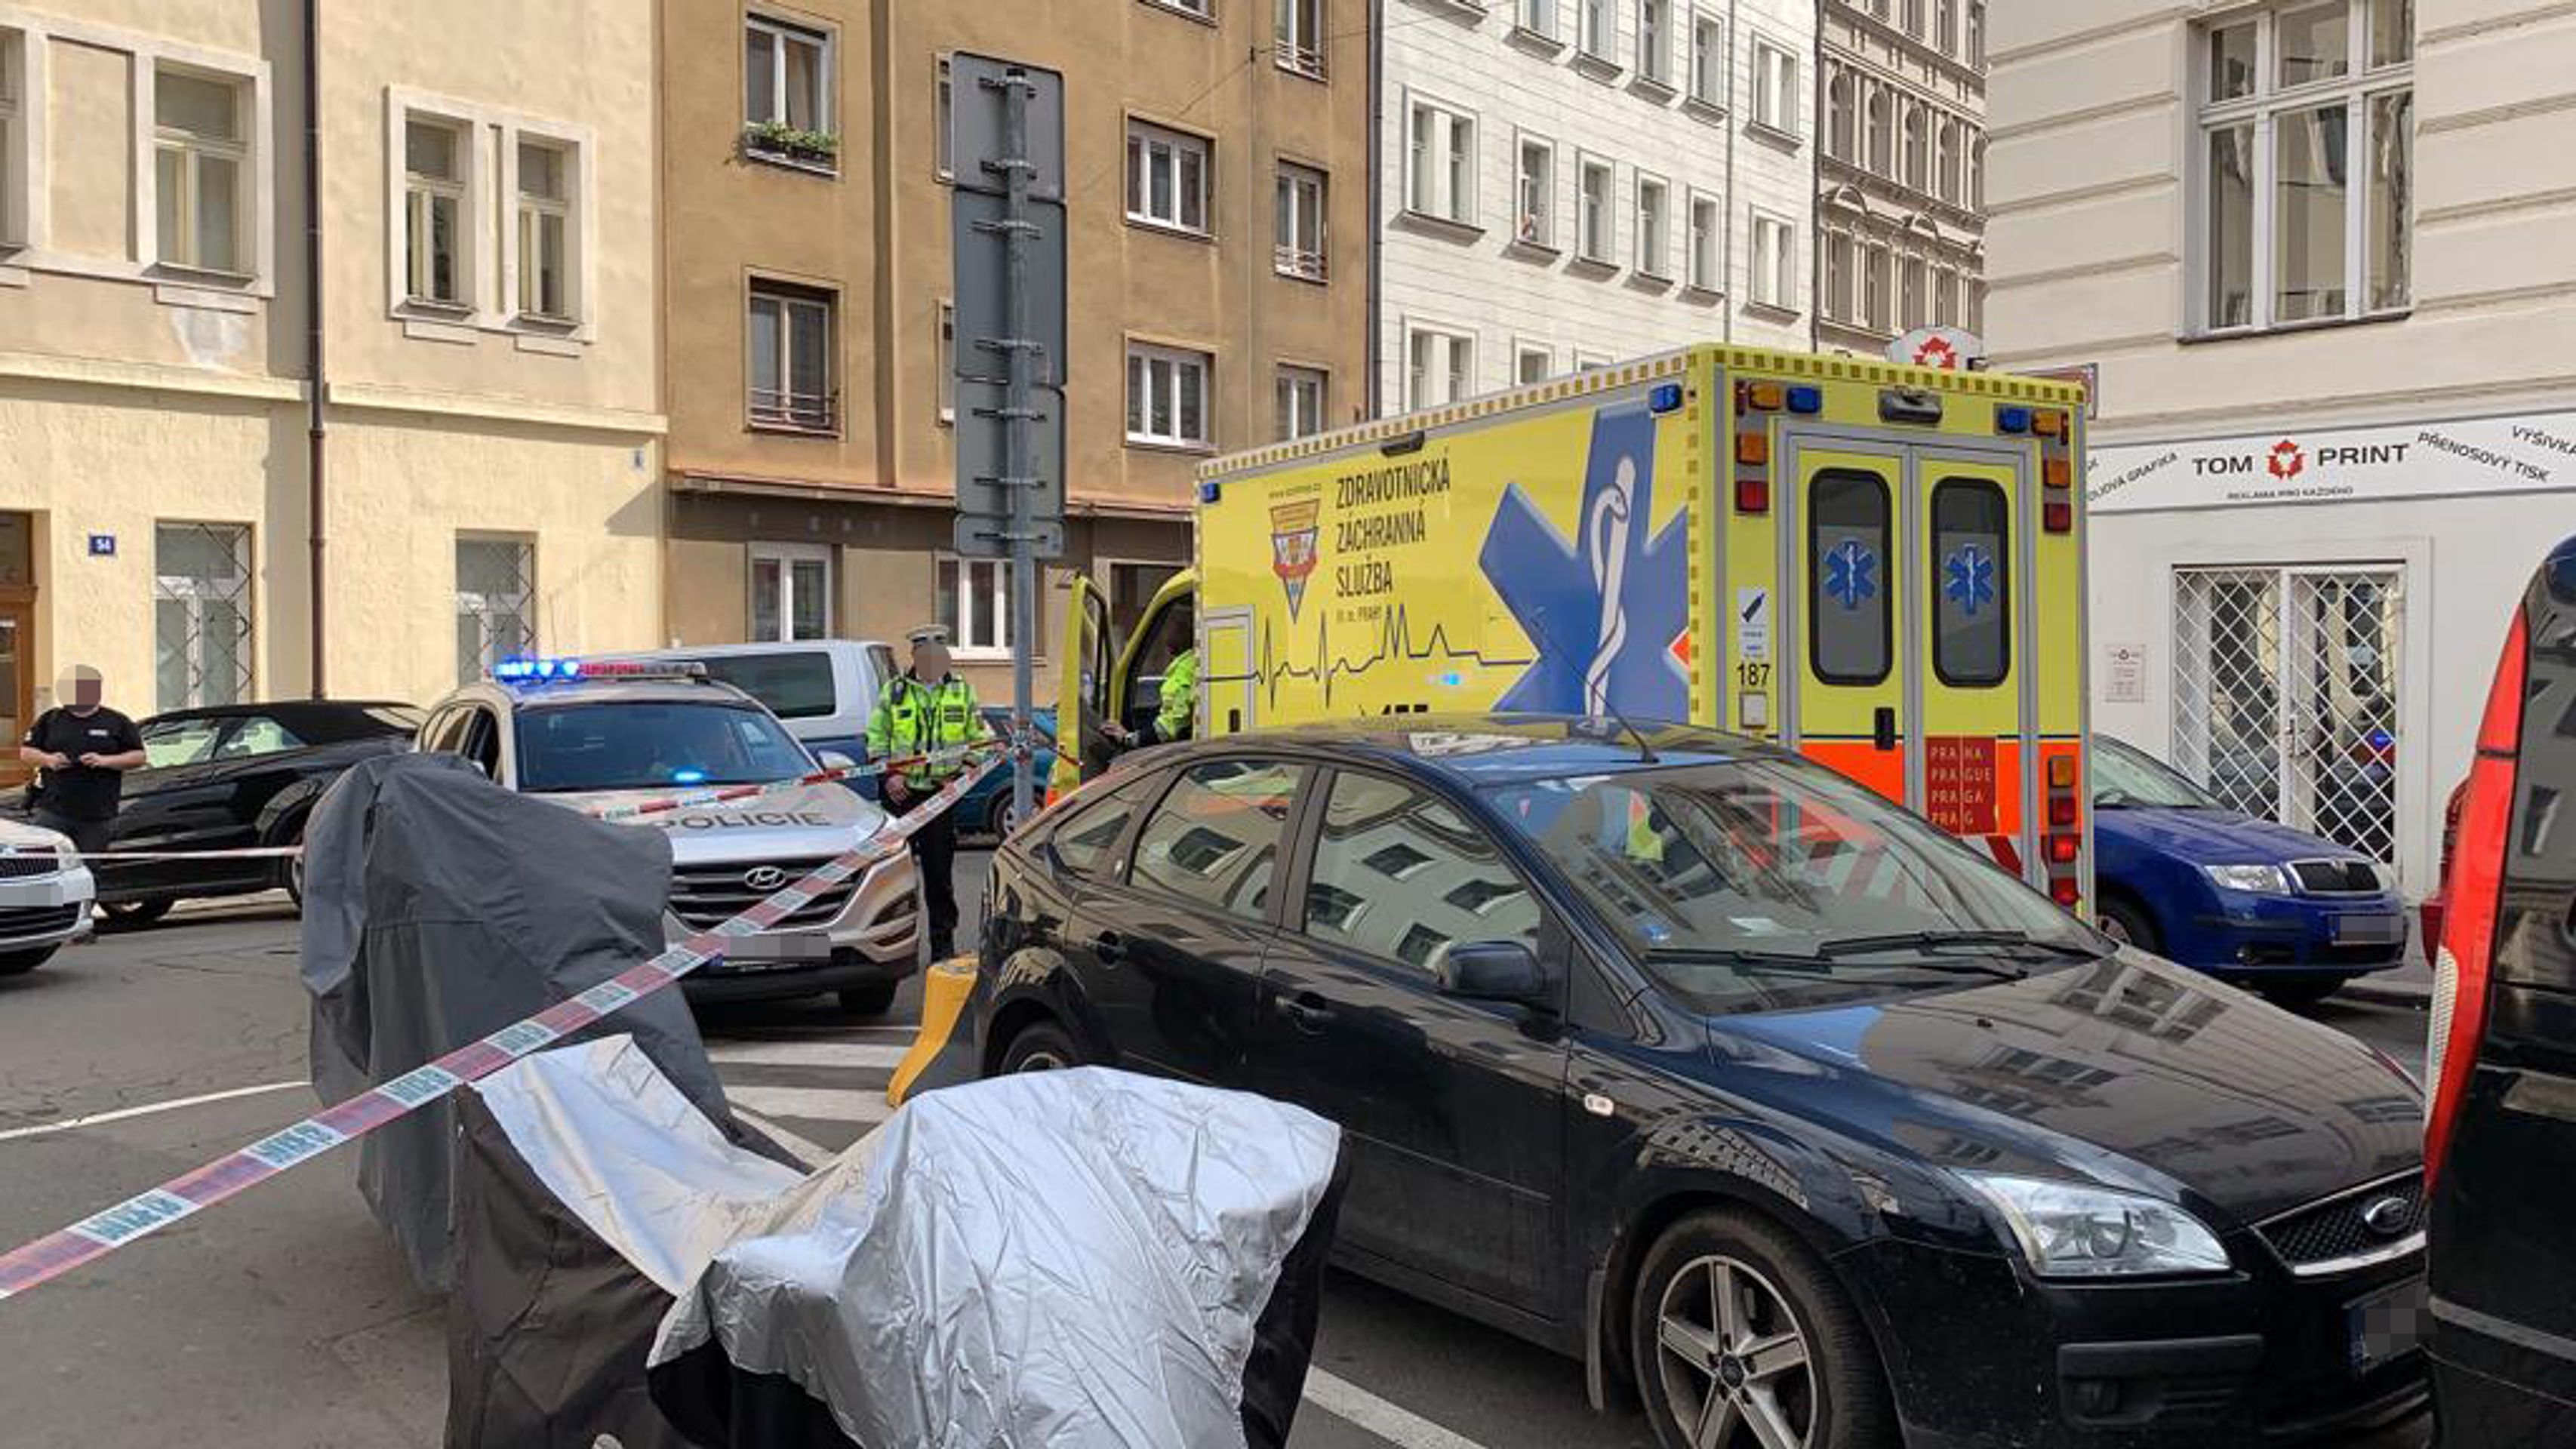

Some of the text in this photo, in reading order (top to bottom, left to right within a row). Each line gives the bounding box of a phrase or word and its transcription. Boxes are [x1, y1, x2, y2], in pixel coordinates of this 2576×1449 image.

[2192, 443, 2410, 475] TOM PRINT
[1335, 446, 1451, 509] ZDRAVOTNICKÁ
[2513, 460, 2550, 482] TISK
[1335, 498, 1426, 553] ZÁCHRANNÁ
[1335, 554, 1393, 597] SLUŽBA
[1737, 662, 1771, 685] 187
[1931, 746, 1984, 760] PRAHA
[1931, 767, 1992, 782] PRAGUE
[1931, 789, 1984, 804] PRAGA
[1931, 811, 1974, 827] PRAG
